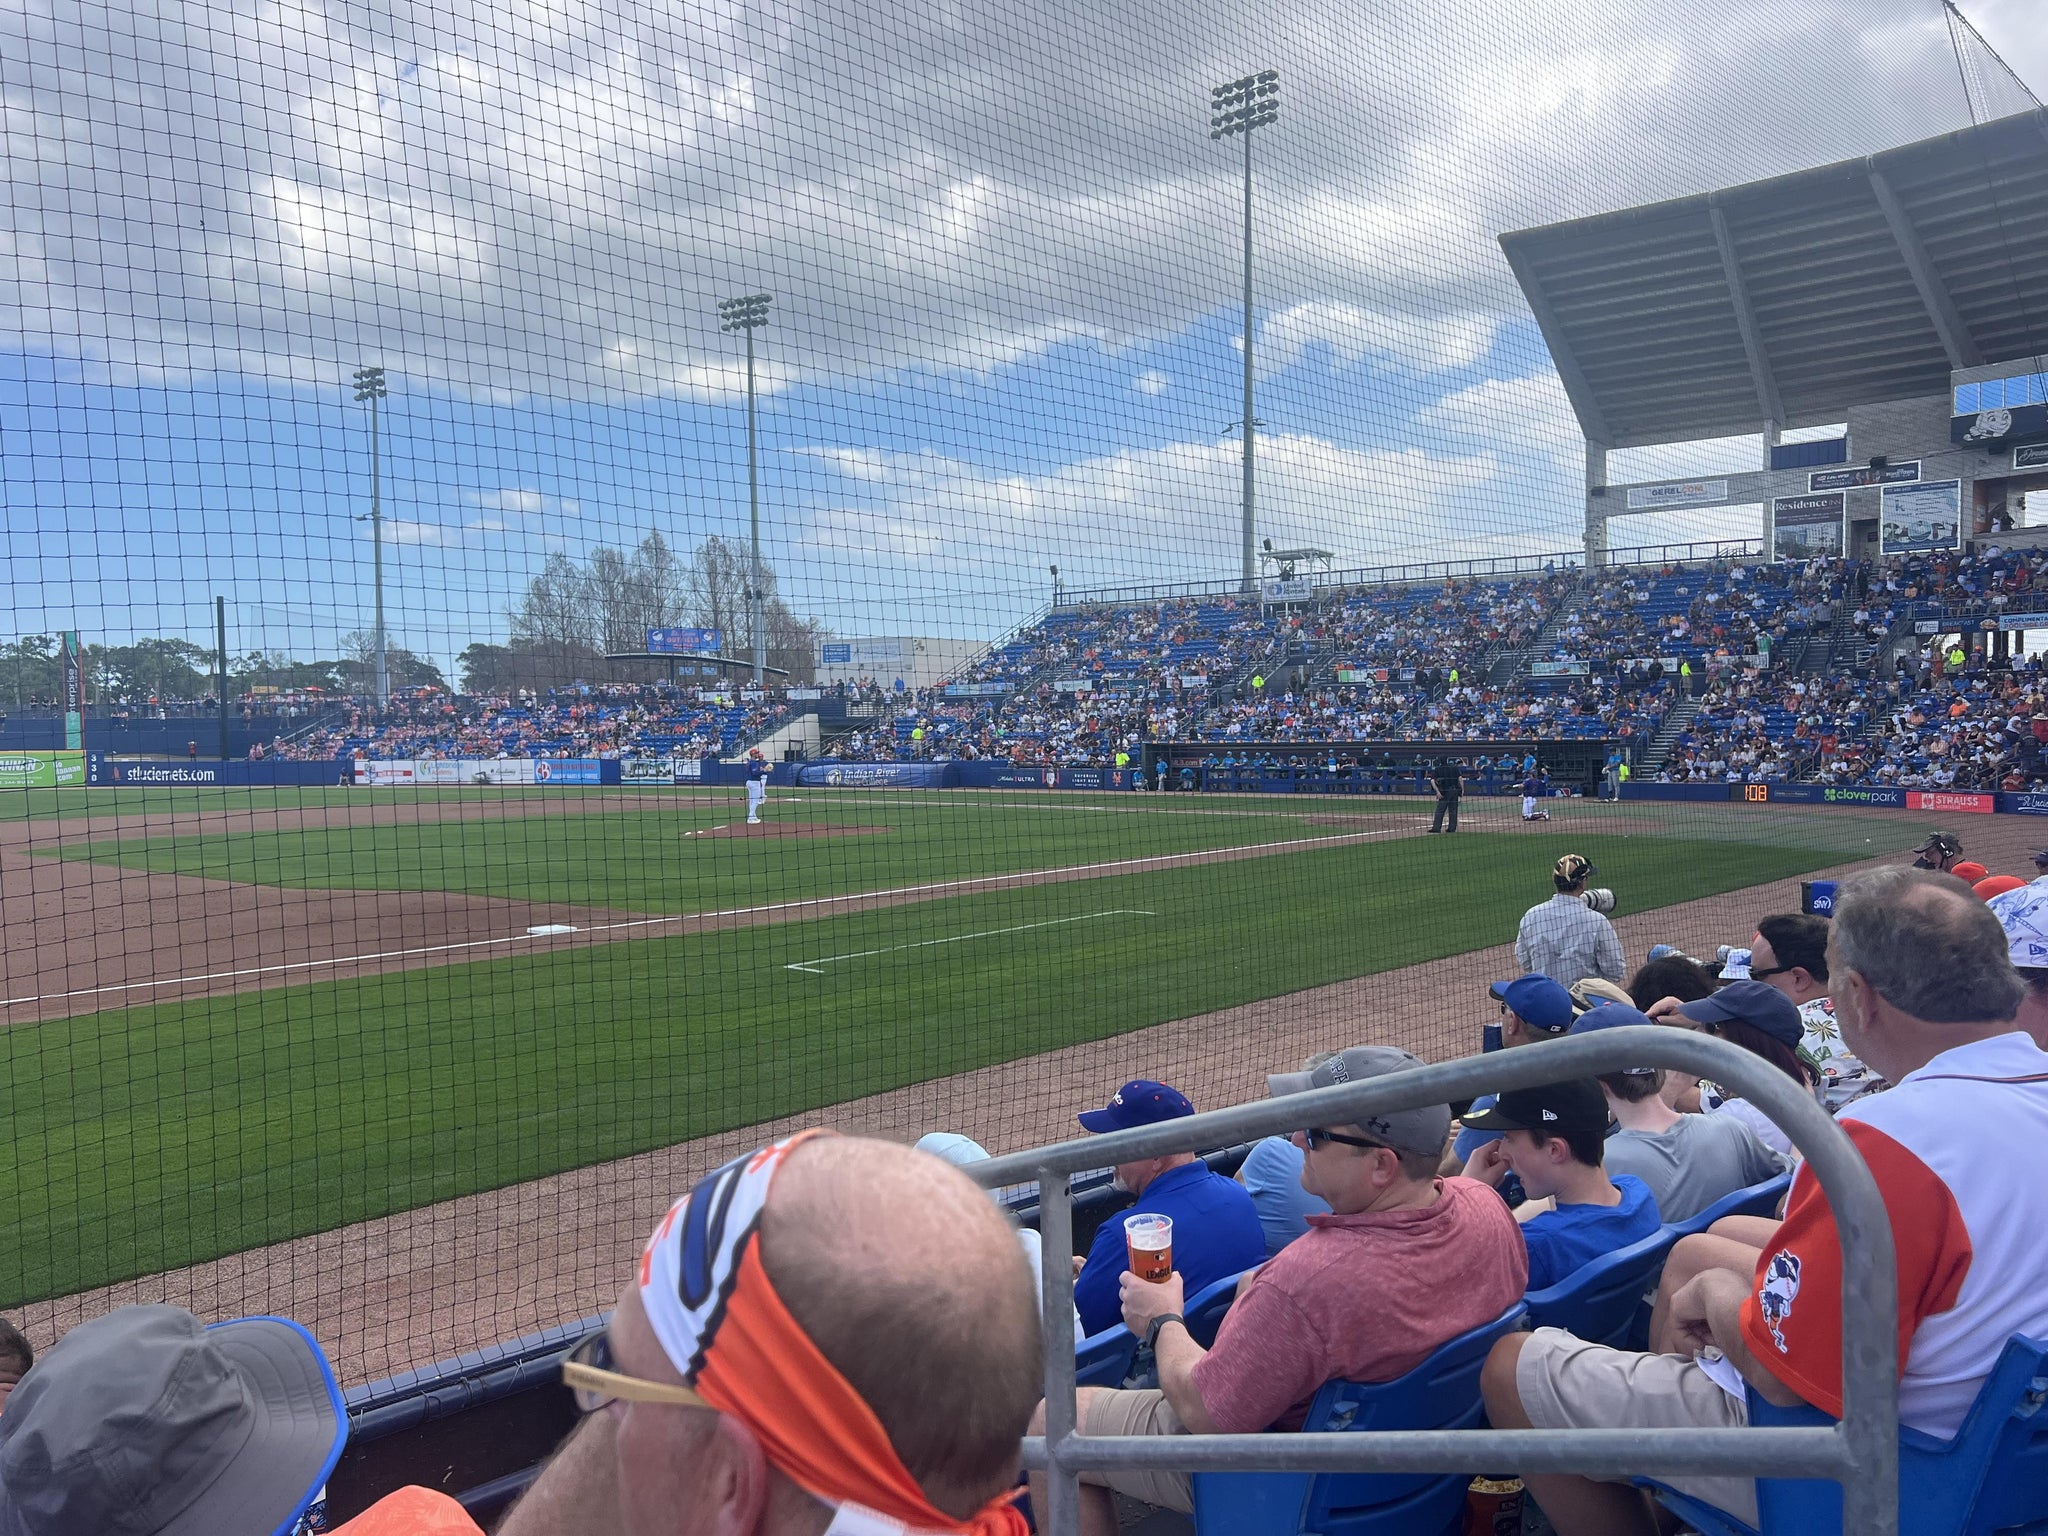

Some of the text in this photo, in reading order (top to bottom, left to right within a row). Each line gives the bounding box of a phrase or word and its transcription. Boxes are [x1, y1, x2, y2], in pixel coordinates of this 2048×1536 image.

[1776, 500, 1827, 511] Residence
[128, 766, 215, 781] stluciemets.com
[844, 768, 900, 778] Indian River
[862, 778, 888, 786] College
[1935, 795, 1979, 806] STRAUSS
[1813, 898, 1831, 909] SNY
